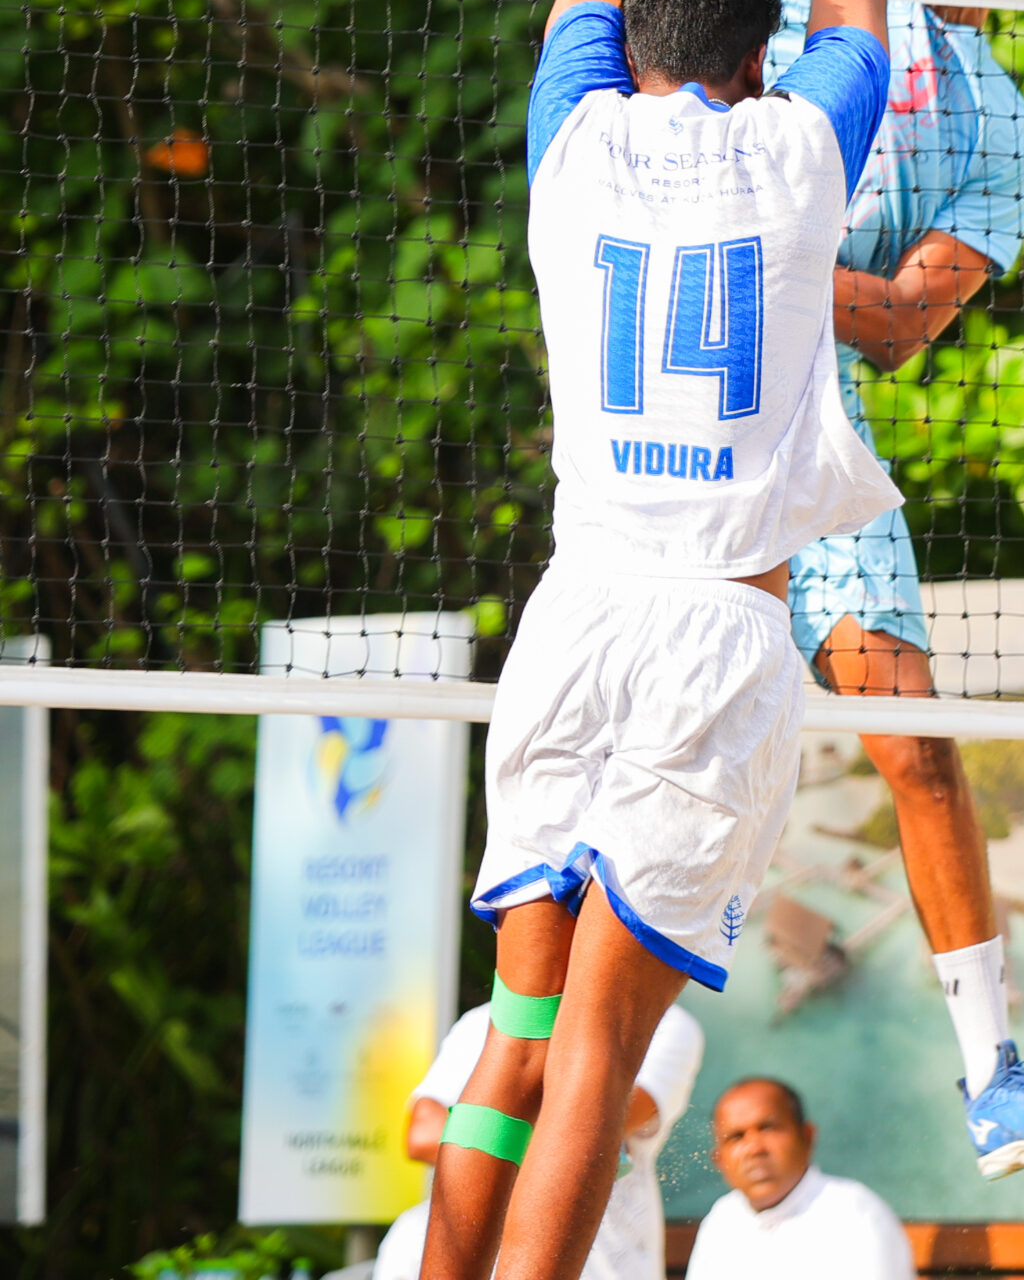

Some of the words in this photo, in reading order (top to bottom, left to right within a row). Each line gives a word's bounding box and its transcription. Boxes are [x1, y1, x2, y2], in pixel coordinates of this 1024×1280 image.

[651, 177, 706, 189] RESOR
[594, 234, 763, 421] 14
[610, 439, 734, 482] VIDURA
